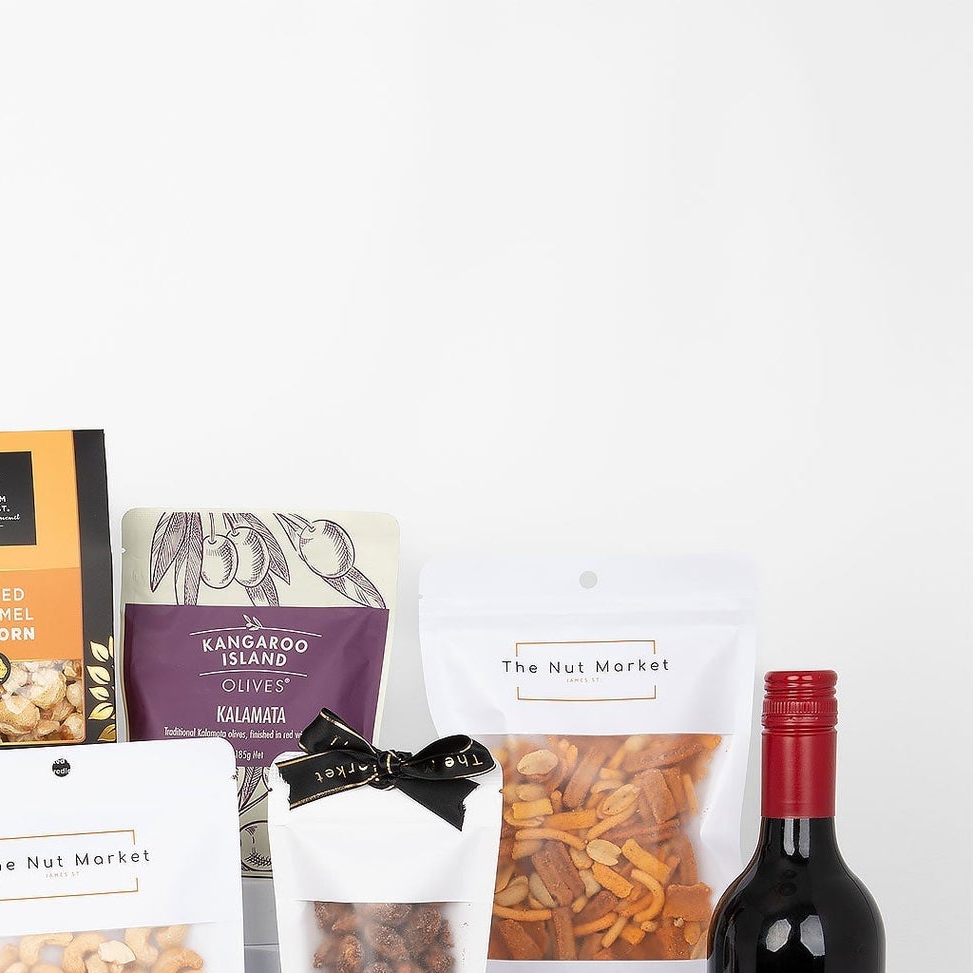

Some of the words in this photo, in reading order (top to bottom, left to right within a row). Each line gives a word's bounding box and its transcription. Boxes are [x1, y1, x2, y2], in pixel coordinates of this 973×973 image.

[202, 634, 309, 654] KANGAROO
[221, 651, 287, 667] ISLAND
[501, 660, 538, 674] The
[549, 661, 585, 674] Nut
[595, 658, 670, 673] Market
[217, 705, 286, 724] KALAMATA
[163, 726, 196, 737] Traditional
[197, 728, 227, 738] Kalamata
[227, 729, 248, 739] olives,
[249, 729, 274, 739] finished
[275, 729, 283, 739] in
[283, 729, 294, 739] red
[252, 750, 264, 760] Net
[27, 855, 64, 870] Nut
[75, 849, 151, 867] Market
